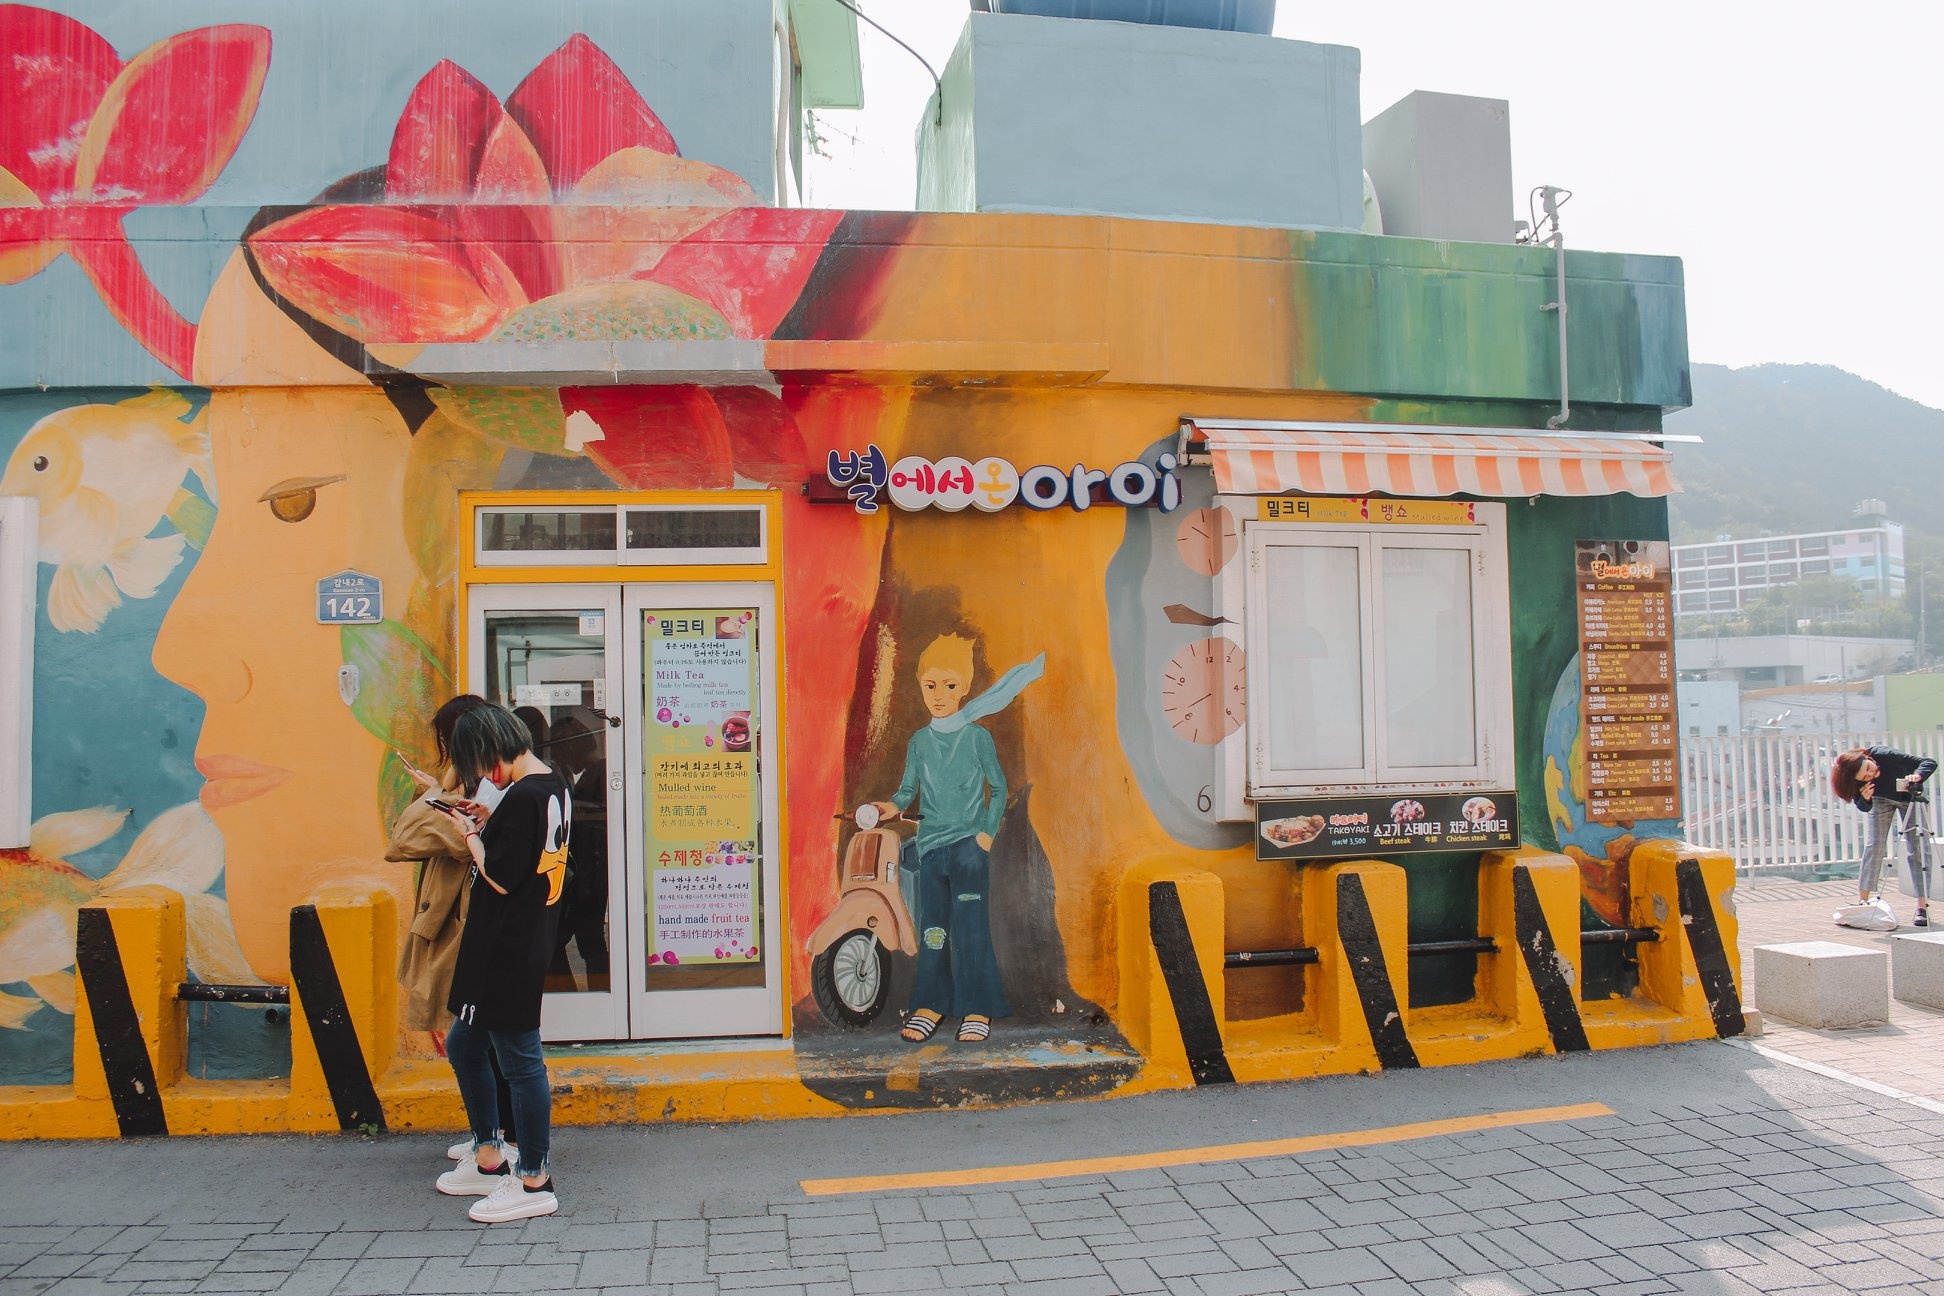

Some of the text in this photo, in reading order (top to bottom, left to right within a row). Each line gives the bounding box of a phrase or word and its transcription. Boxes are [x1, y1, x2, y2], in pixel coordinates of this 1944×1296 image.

[1267, 500, 1310, 518] 밀크티
[334, 579, 364, 587] 감내2로
[327, 598, 371, 617] 142
[661, 620, 704, 636] 밀크티
[656, 671, 704, 679] Milk Tea
[674, 682, 681, 690] by
[657, 696, 680, 707] 奶茶
[710, 700, 727, 708] 奶茶
[1225, 708, 1232, 716] 6
[659, 783, 716, 792] Mulled wine
[1197, 784, 1211, 813] 6
[660, 805, 707, 817] 热葡萄酒
[1328, 826, 1370, 834] TAKOYAKI
[1374, 822, 1442, 837] 소고기 스테이크
[1450, 820, 1508, 834] 치킨 스테이크
[659, 850, 702, 867] 수제청
[659, 913, 749, 924] hand made fruit tea
[659, 928, 744, 940] 手工制作的水果茶
